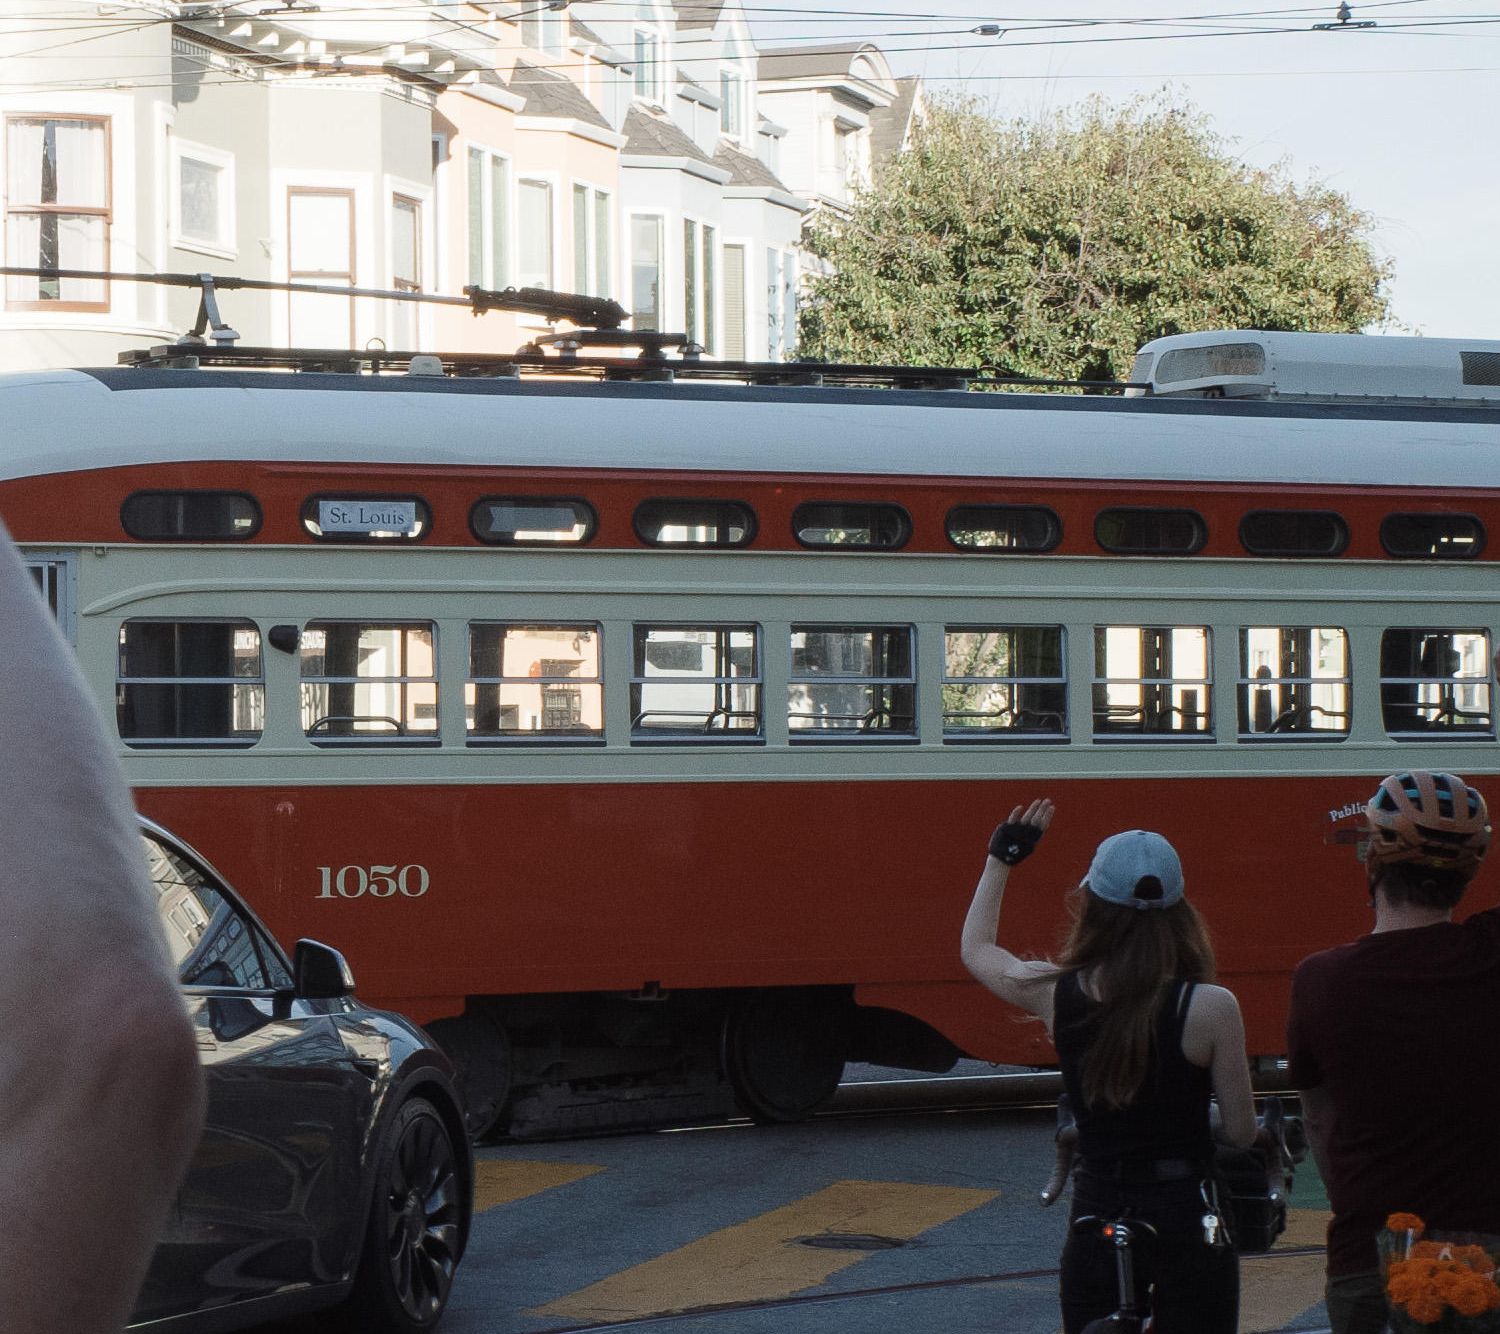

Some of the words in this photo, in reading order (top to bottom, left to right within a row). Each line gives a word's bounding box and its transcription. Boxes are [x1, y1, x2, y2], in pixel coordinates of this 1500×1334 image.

[330, 508, 352, 525] St.
[359, 508, 405, 525] Louis
[1329, 802, 1369, 823] Public
[315, 864, 430, 899] 1050
